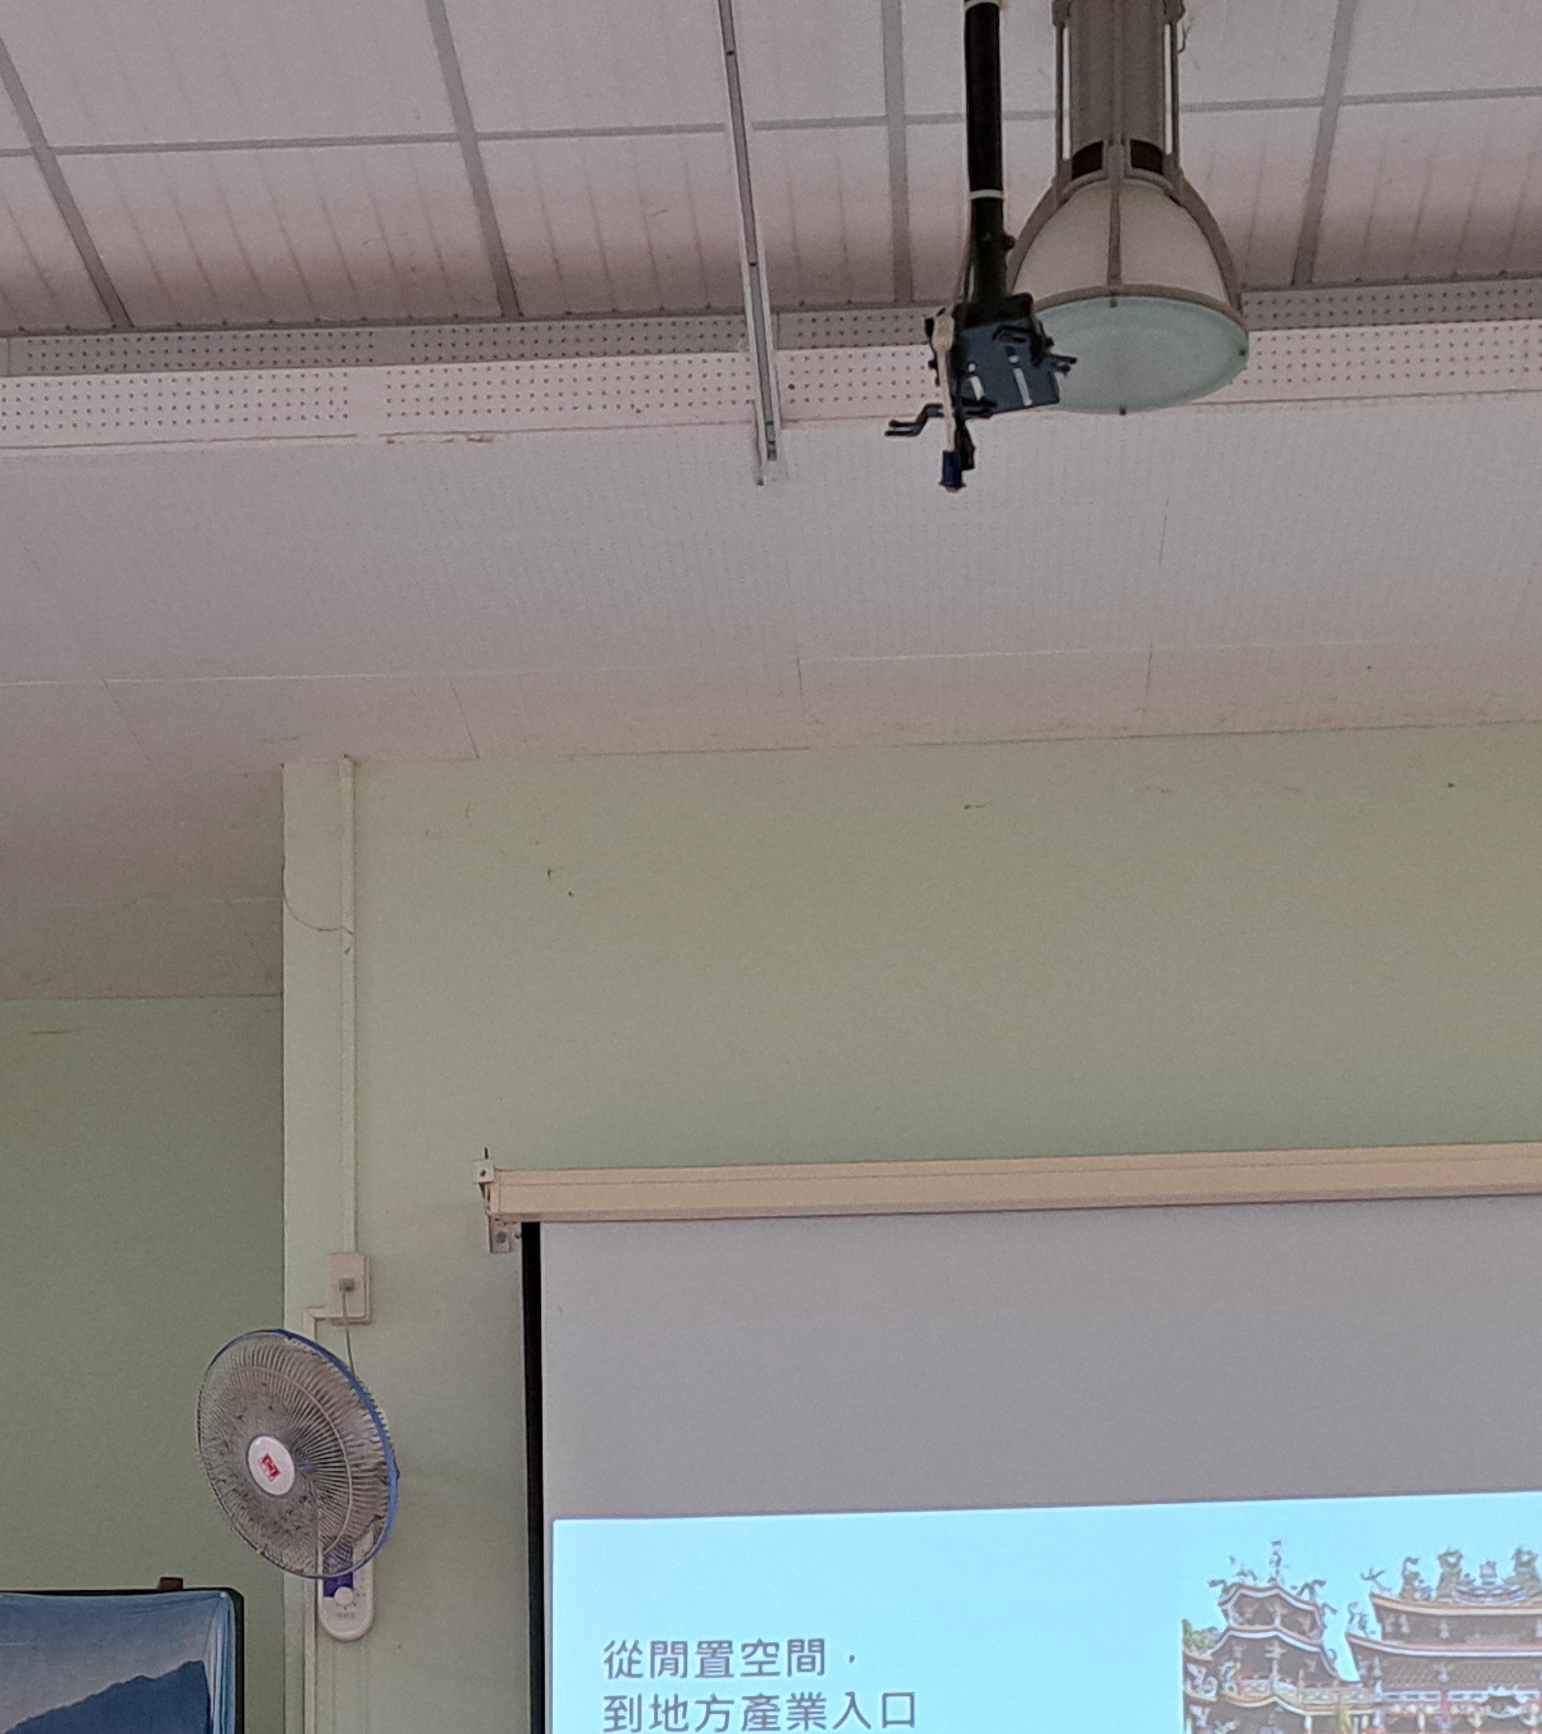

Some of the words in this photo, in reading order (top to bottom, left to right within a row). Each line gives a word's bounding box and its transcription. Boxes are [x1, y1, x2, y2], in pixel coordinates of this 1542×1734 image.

[602, 1690, 917, 1734] 到地方產業入口
